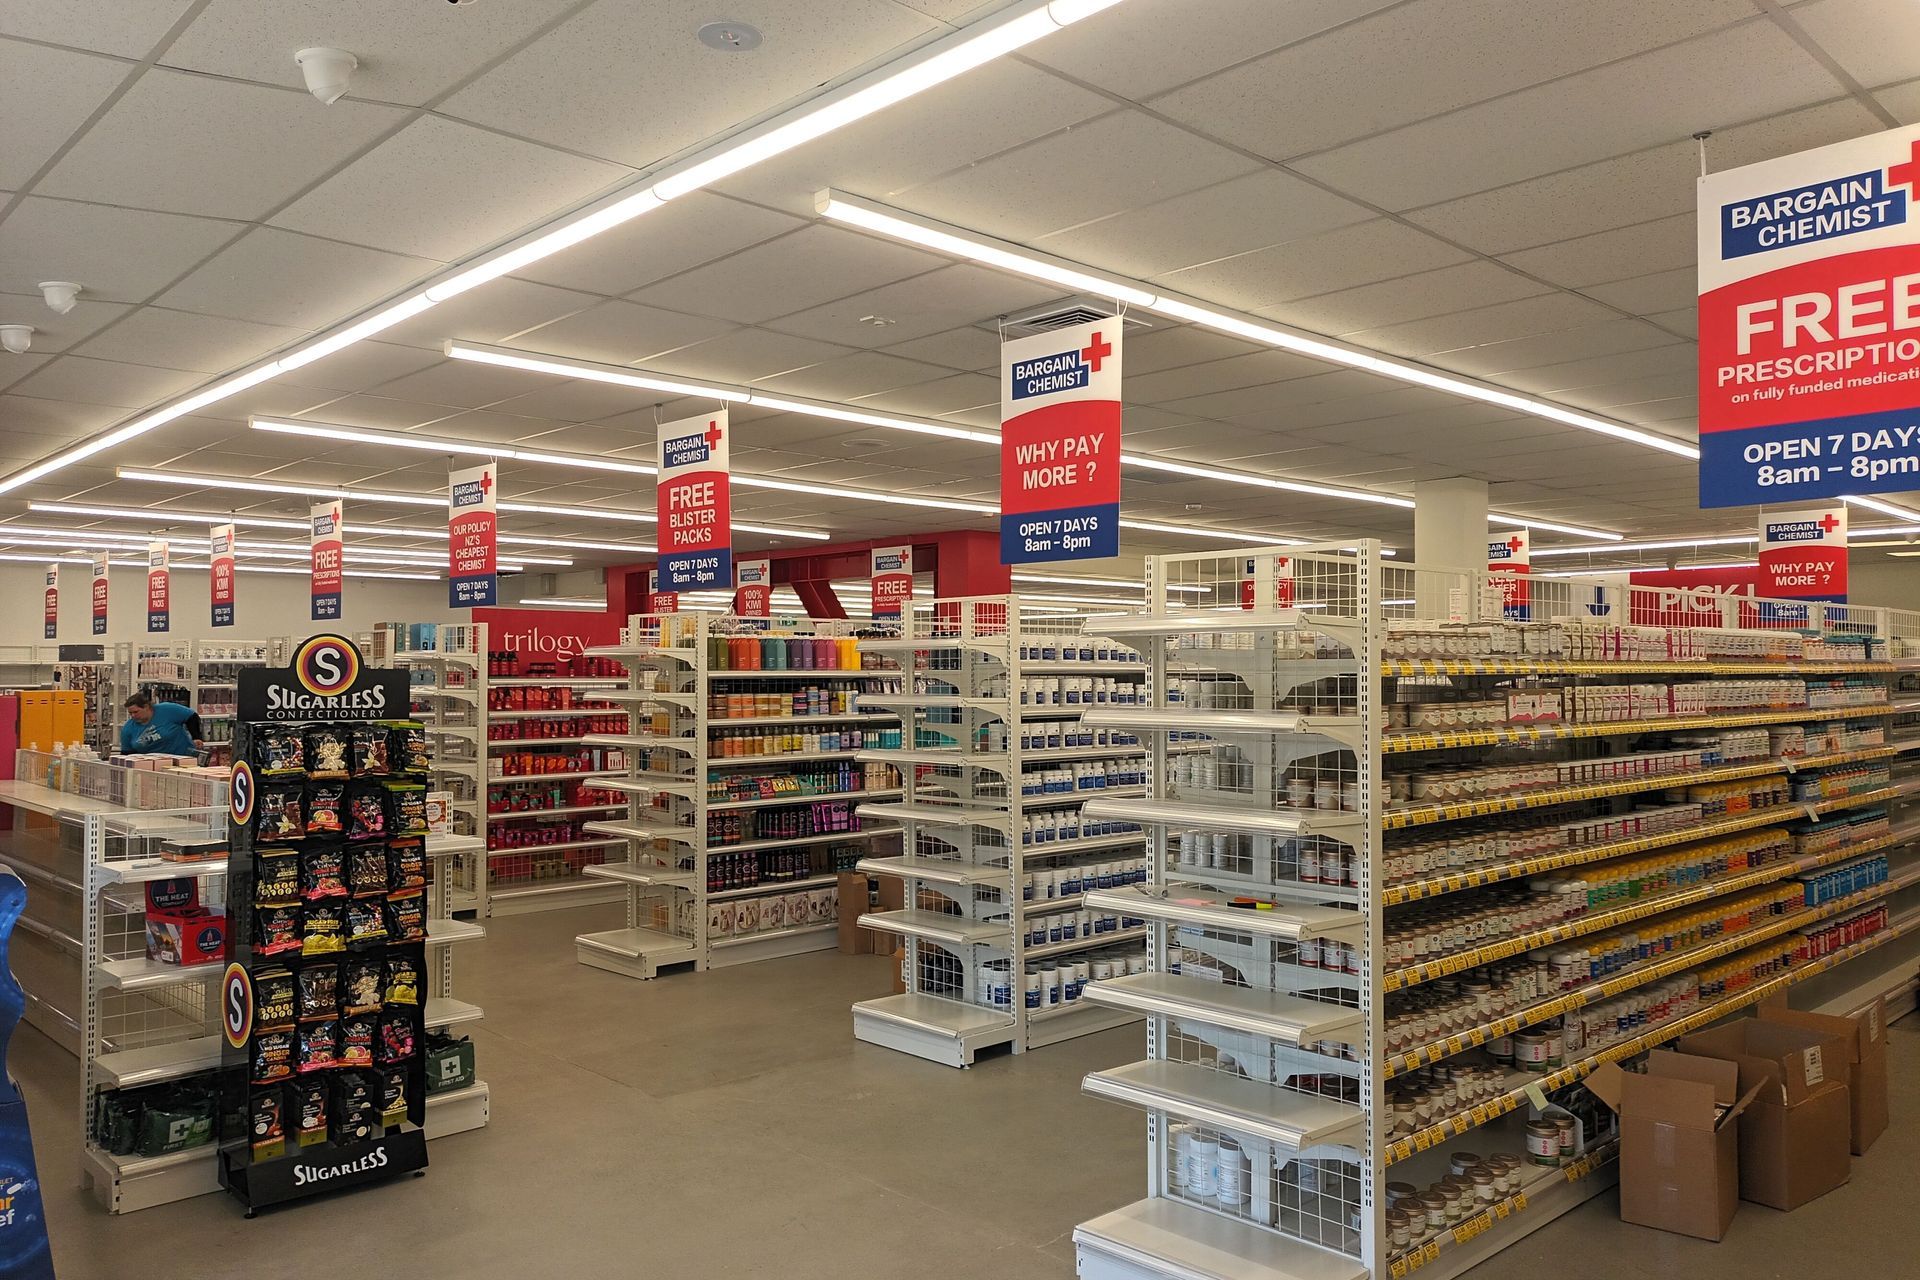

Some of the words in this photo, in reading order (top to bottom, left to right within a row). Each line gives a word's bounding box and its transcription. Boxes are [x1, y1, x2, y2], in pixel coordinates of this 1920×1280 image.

[1731, 178, 1873, 229] BARGAIN
[1758, 200, 1891, 247] CHEMIST
[1736, 273, 1920, 356] FREE
[1016, 354, 1076, 380] BARGAIN
[1027, 370, 1083, 394] CHEMIST
[1731, 391, 1750, 404] on
[1753, 387, 1785, 401] fully
[1788, 377, 1844, 396] funded
[665, 437, 701, 453] BARGAIN
[1015, 439, 1060, 465] WHY
[1063, 432, 1104, 459] PAY
[1743, 436, 1821, 464] OPEN
[1827, 434, 1845, 455] 7
[1851, 426, 1920, 453] DAY
[672, 449, 706, 465] CHEMIST
[1022, 464, 1078, 490] MORE
[1085, 461, 1097, 482] ?
[1757, 465, 1820, 487] 8am
[1850, 455, 1920, 481] 8pm
[454, 483, 479, 496] BARGAIN
[669, 481, 715, 510] FREE
[458, 493, 482, 505] CHEMIST
[669, 509, 716, 528] BLISTER
[1019, 521, 1052, 536] OPEN
[1054, 520, 1062, 533] 7
[1063, 516, 1098, 532] DAYS
[453, 524, 467, 536] OUR
[467, 521, 491, 533] POLICY
[1769, 522, 1814, 533] BARGAIN
[1778, 529, 1820, 541] CHEMIST
[464, 535, 481, 546] NZ'S
[673, 527, 712, 546] PACKS
[1024, 537, 1051, 552] 8am
[1062, 534, 1091, 551] 8pm
[315, 549, 338, 570] FREE
[455, 546, 489, 559] CHEAPEST
[215, 564, 230, 577] 100%
[458, 559, 486, 571] CHEMIST
[669, 559, 690, 572] OPEN
[691, 559, 696, 569] 7
[696, 557, 718, 569] DAYS
[1769, 563, 1801, 574] WHY
[1805, 561, 1835, 573] PAY
[151, 575, 166, 589] FREE
[672, 572, 690, 583] 8am
[696, 570, 714, 583] 8pm
[1775, 575, 1816, 586] MORE
[1822, 574, 1831, 585] ?
[456, 582, 471, 592] OPEN
[474, 581, 489, 590] DAYS
[744, 589, 763, 600] 100%
[877, 580, 907, 595] FREE
[458, 592, 470, 601] 8am
[474, 591, 486, 601] 8pm
[654, 595, 673, 606] FREE
[745, 599, 762, 610] KIWI
[1660, 584, 1741, 613] PICK
[503, 626, 591, 662] trilogy
[315, 647, 341, 686] S
[266, 684, 386, 710] SUGARLESS
[266, 709, 385, 719] CONFECTIONERY
[234, 772, 247, 814] S
[229, 978, 243, 1033] S
[293, 1146, 388, 1186] SUGARLESS
